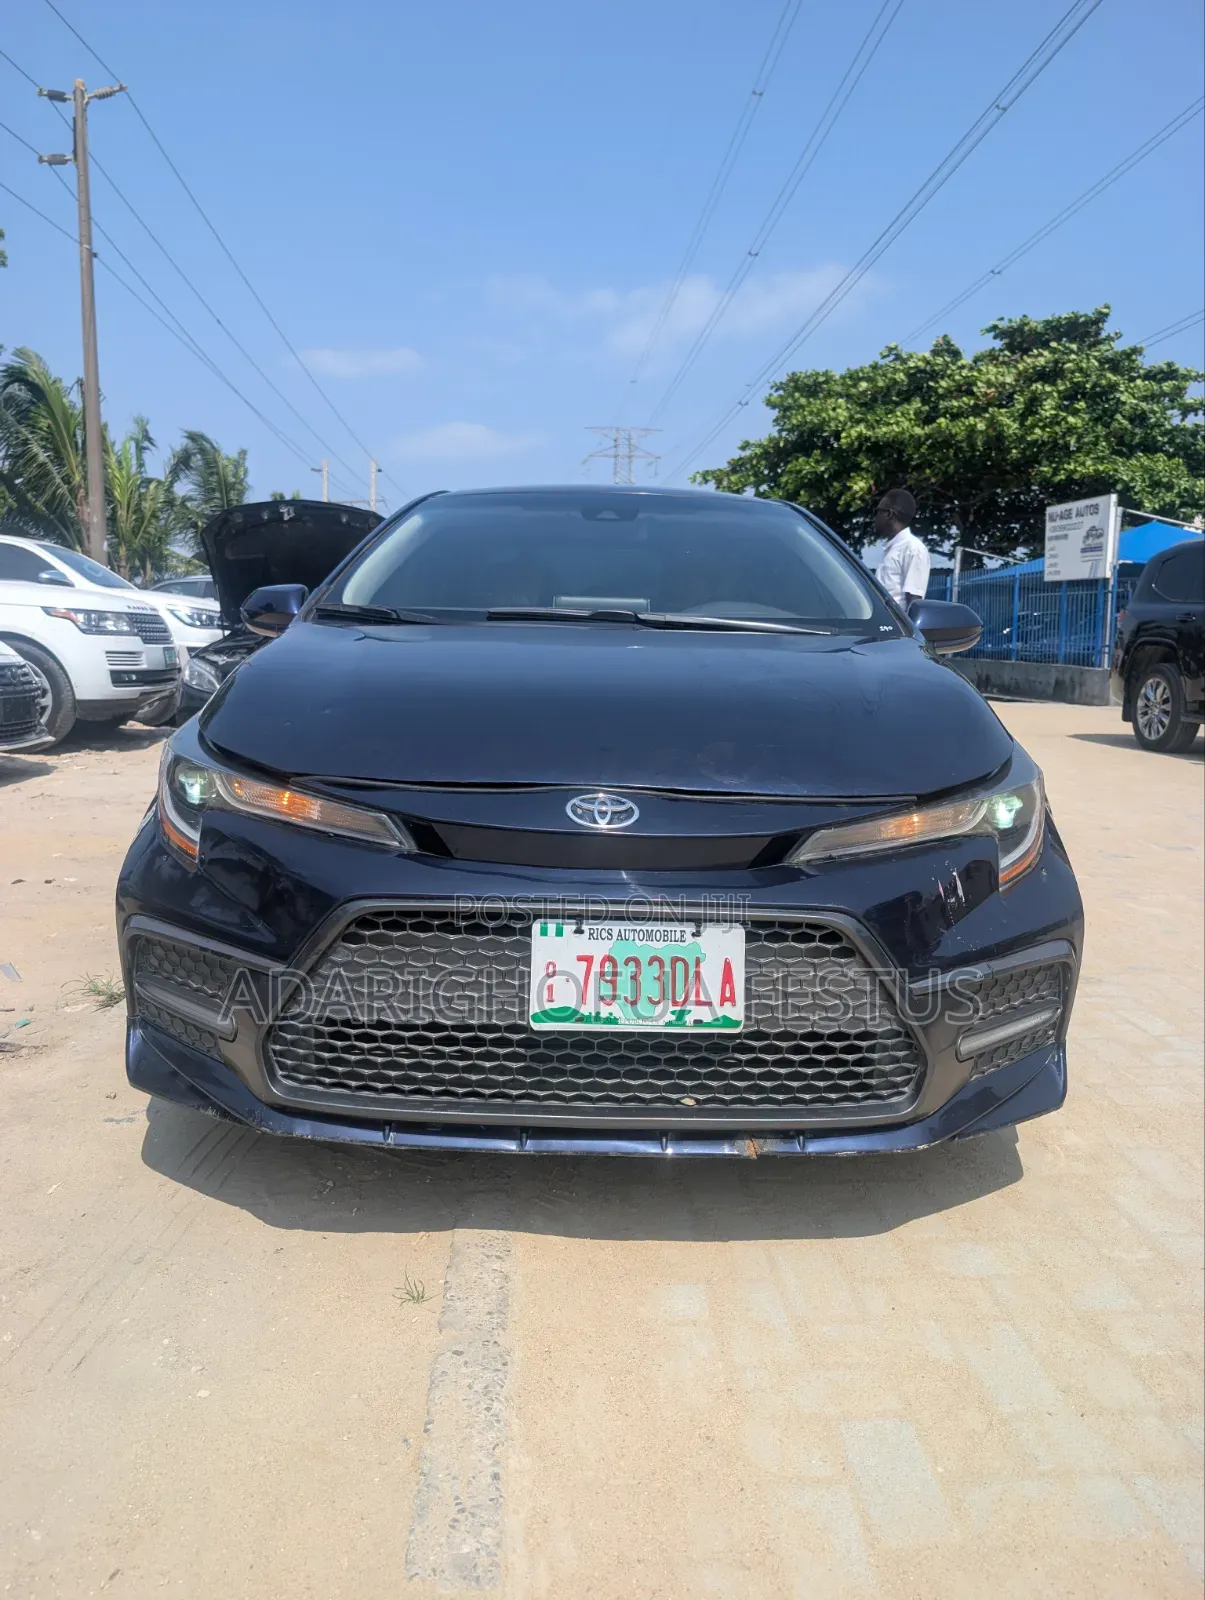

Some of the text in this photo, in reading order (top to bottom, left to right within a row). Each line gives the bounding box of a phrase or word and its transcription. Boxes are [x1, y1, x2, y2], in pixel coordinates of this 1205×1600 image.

[1048, 503, 1099, 522] NU-AGE AUTOS
[588, 928, 687, 943] RICS AUTOMOBILE
